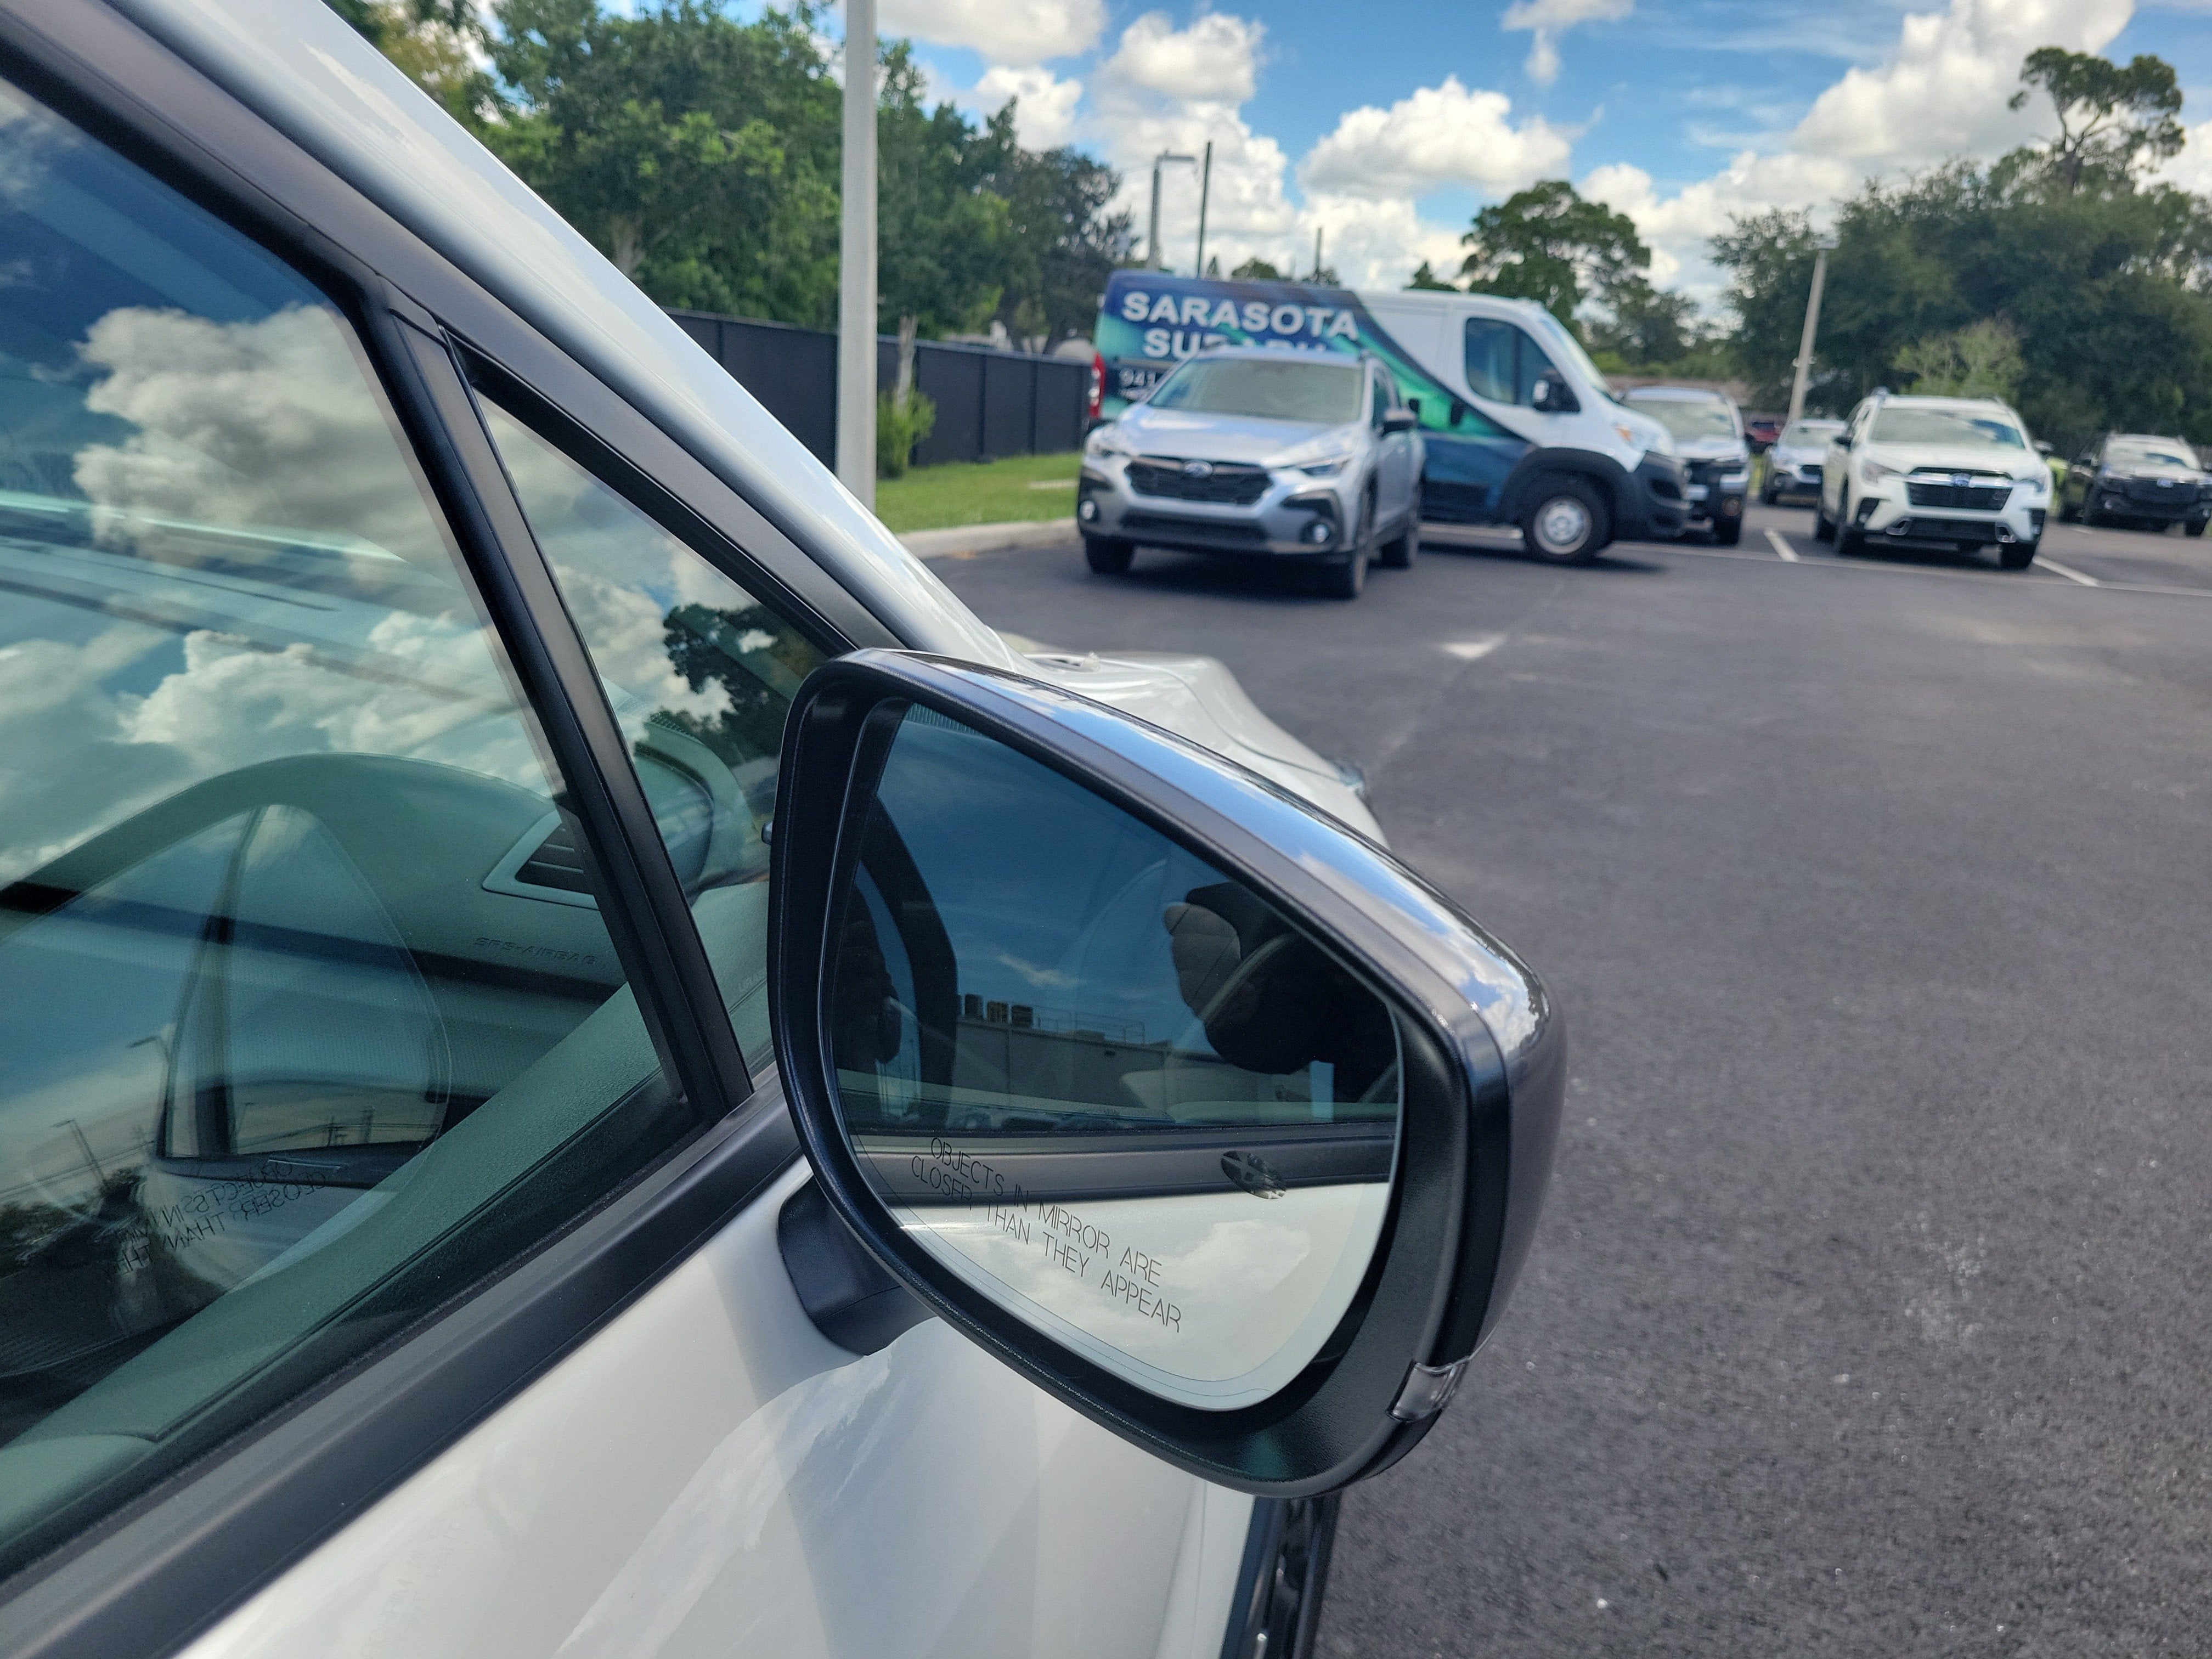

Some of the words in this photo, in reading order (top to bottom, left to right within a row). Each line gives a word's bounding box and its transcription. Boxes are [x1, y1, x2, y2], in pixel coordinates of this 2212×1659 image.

[1122, 292, 1358, 341] SARASOTA
[911, 1155, 973, 1211] CLOSER
[985, 1198, 1030, 1245] THAN
[1042, 1231, 1090, 1277] THEY
[1101, 1269, 1181, 1333] APPEAR
[931, 1137, 1005, 1196] OBJECTS
[1014, 1183, 1029, 1212] IN
[1039, 1199, 1110, 1259] MIRROR
[1120, 1246, 1162, 1288] ARE
